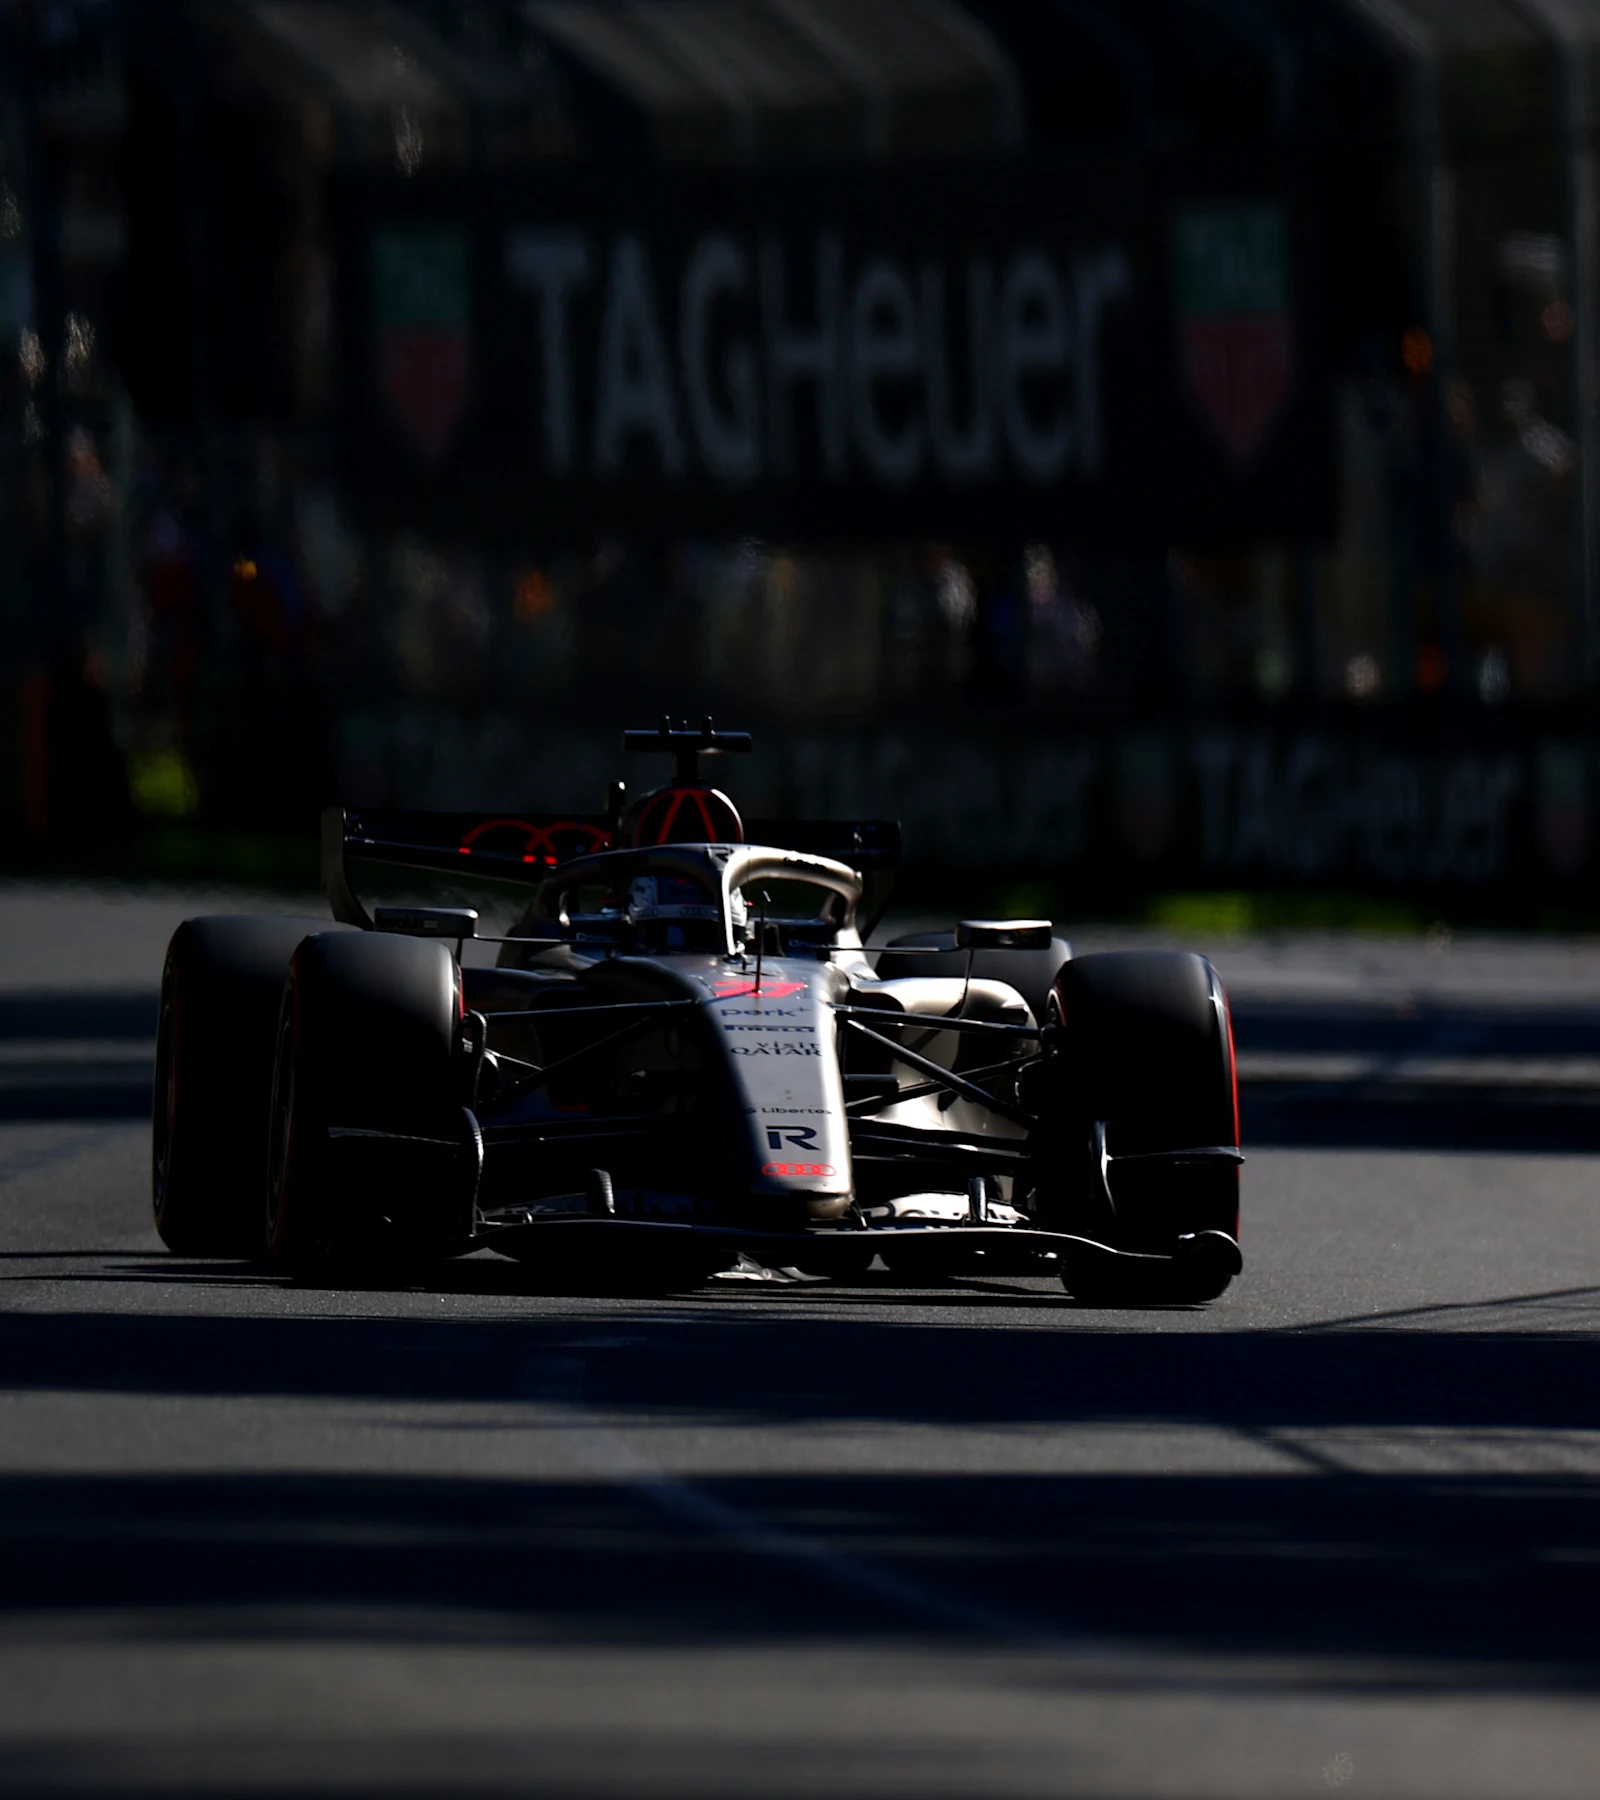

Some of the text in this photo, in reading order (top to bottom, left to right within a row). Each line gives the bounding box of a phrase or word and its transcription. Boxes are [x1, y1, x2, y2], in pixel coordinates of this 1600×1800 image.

[502, 223, 1134, 492] TAGHeuer
[729, 1047, 821, 1057] QATAR
[766, 1125, 821, 1151] R
